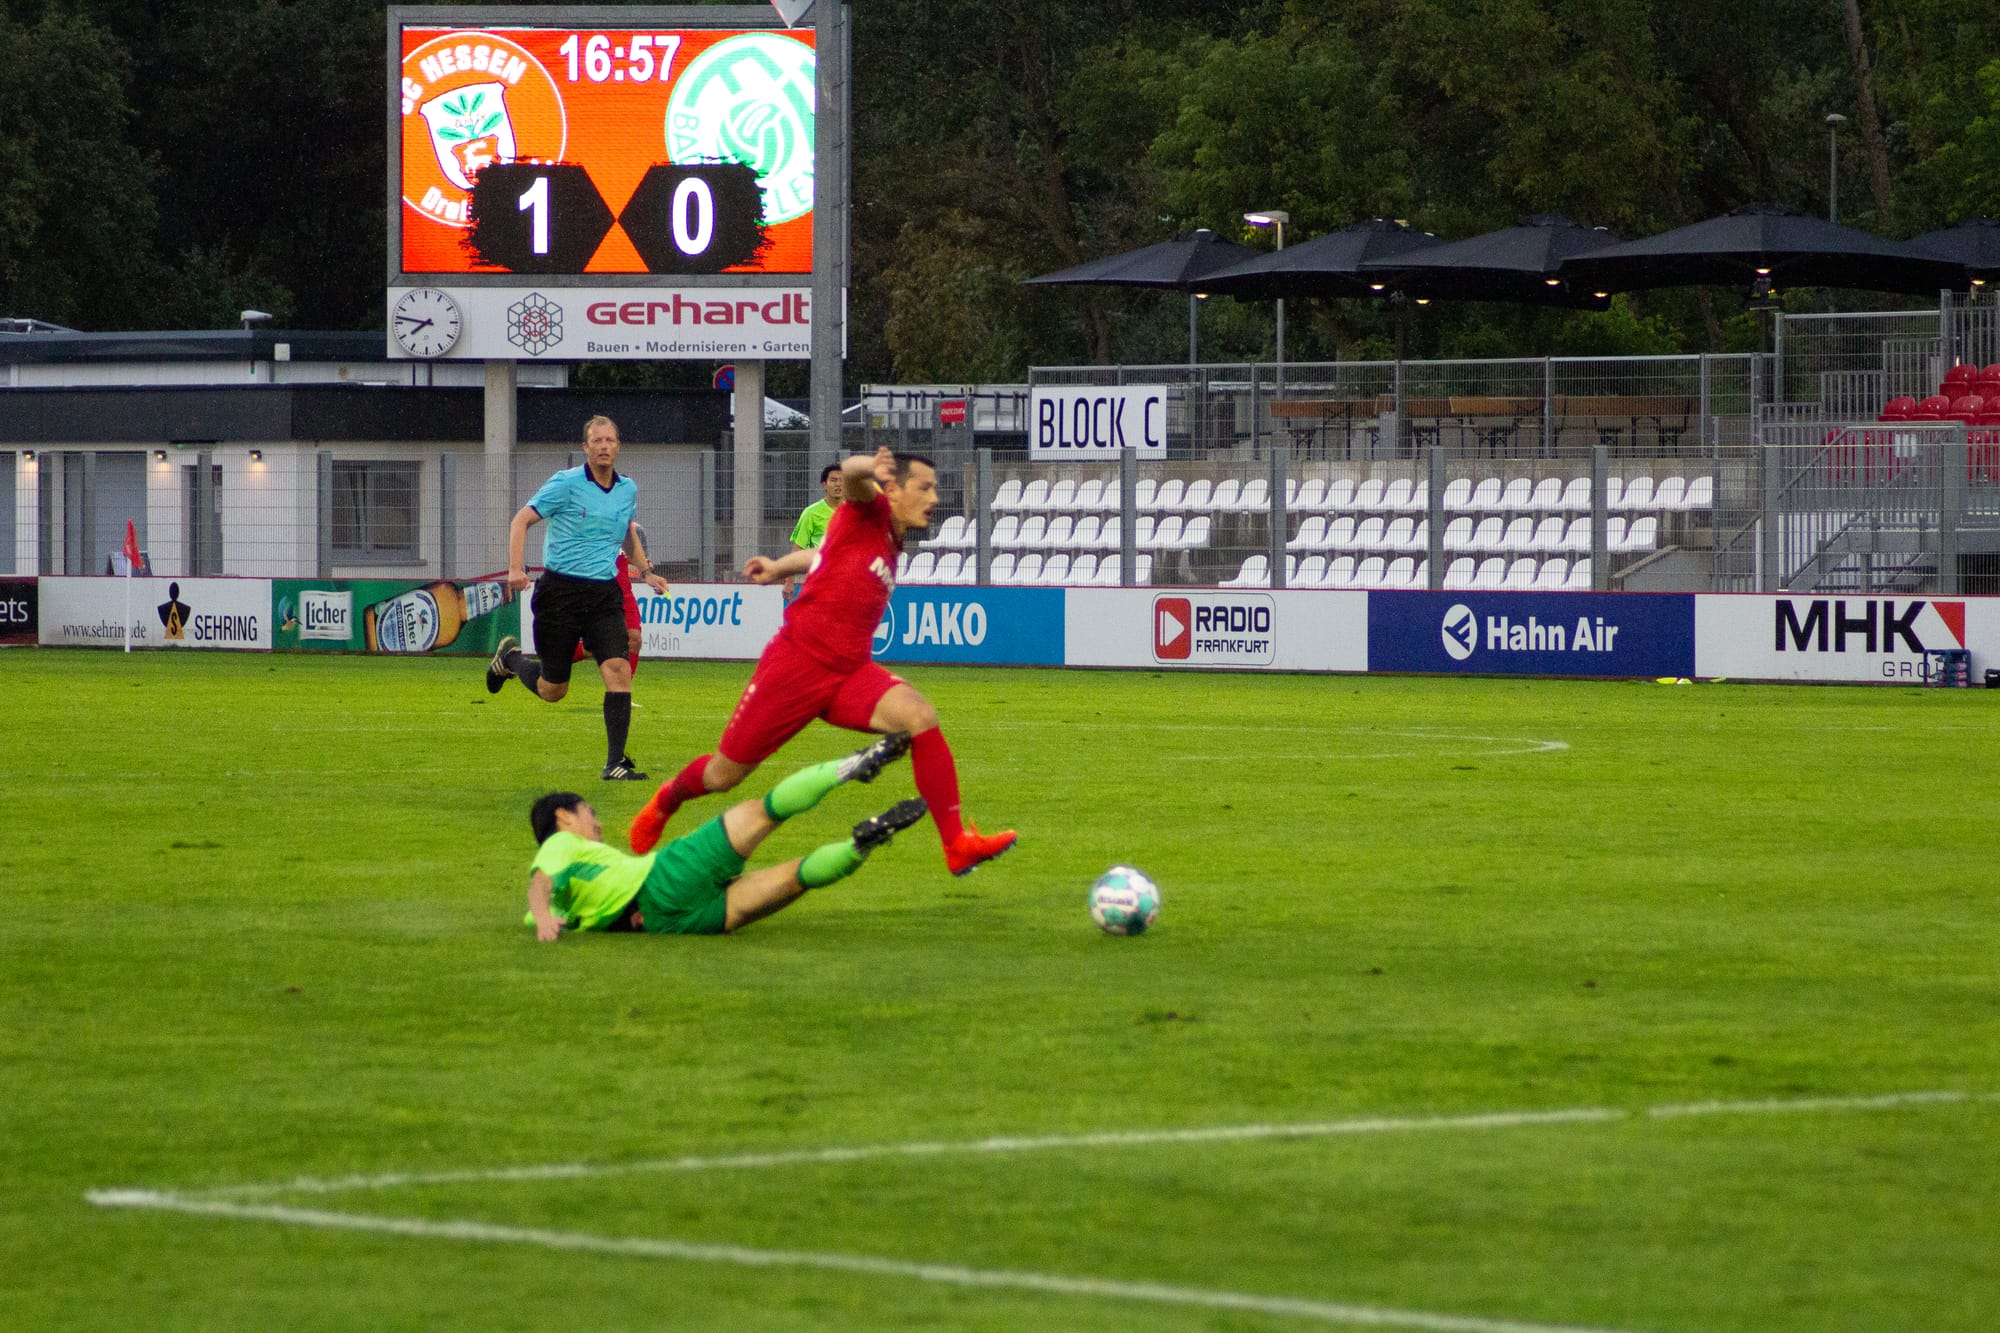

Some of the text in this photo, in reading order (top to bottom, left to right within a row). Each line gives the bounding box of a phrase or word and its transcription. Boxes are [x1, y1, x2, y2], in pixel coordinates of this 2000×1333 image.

[419, 45, 528, 84] HESSEN
[560, 34, 681, 82] 16:57
[421, 186, 472, 221] Drei
[519, 177, 549, 254] 1
[671, 177, 715, 255] 0
[586, 293, 810, 325] Gerhardt
[587, 340, 809, 352] Bauen Modernisieren Garten
[1039, 396, 1160, 448] BLOCK C
[62, 620, 147, 639] www.sehrin.de
[194, 615, 258, 641] SEHRING
[305, 600, 347, 630] Licher
[403, 602, 417, 646] Licher
[902, 602, 987, 646] JAKO
[1196, 606, 1270, 632] RADIO
[1775, 599, 1926, 653] MHK
[1196, 640, 1269, 653] FRANKFURT
[1487, 616, 1619, 651] Hahn Air
